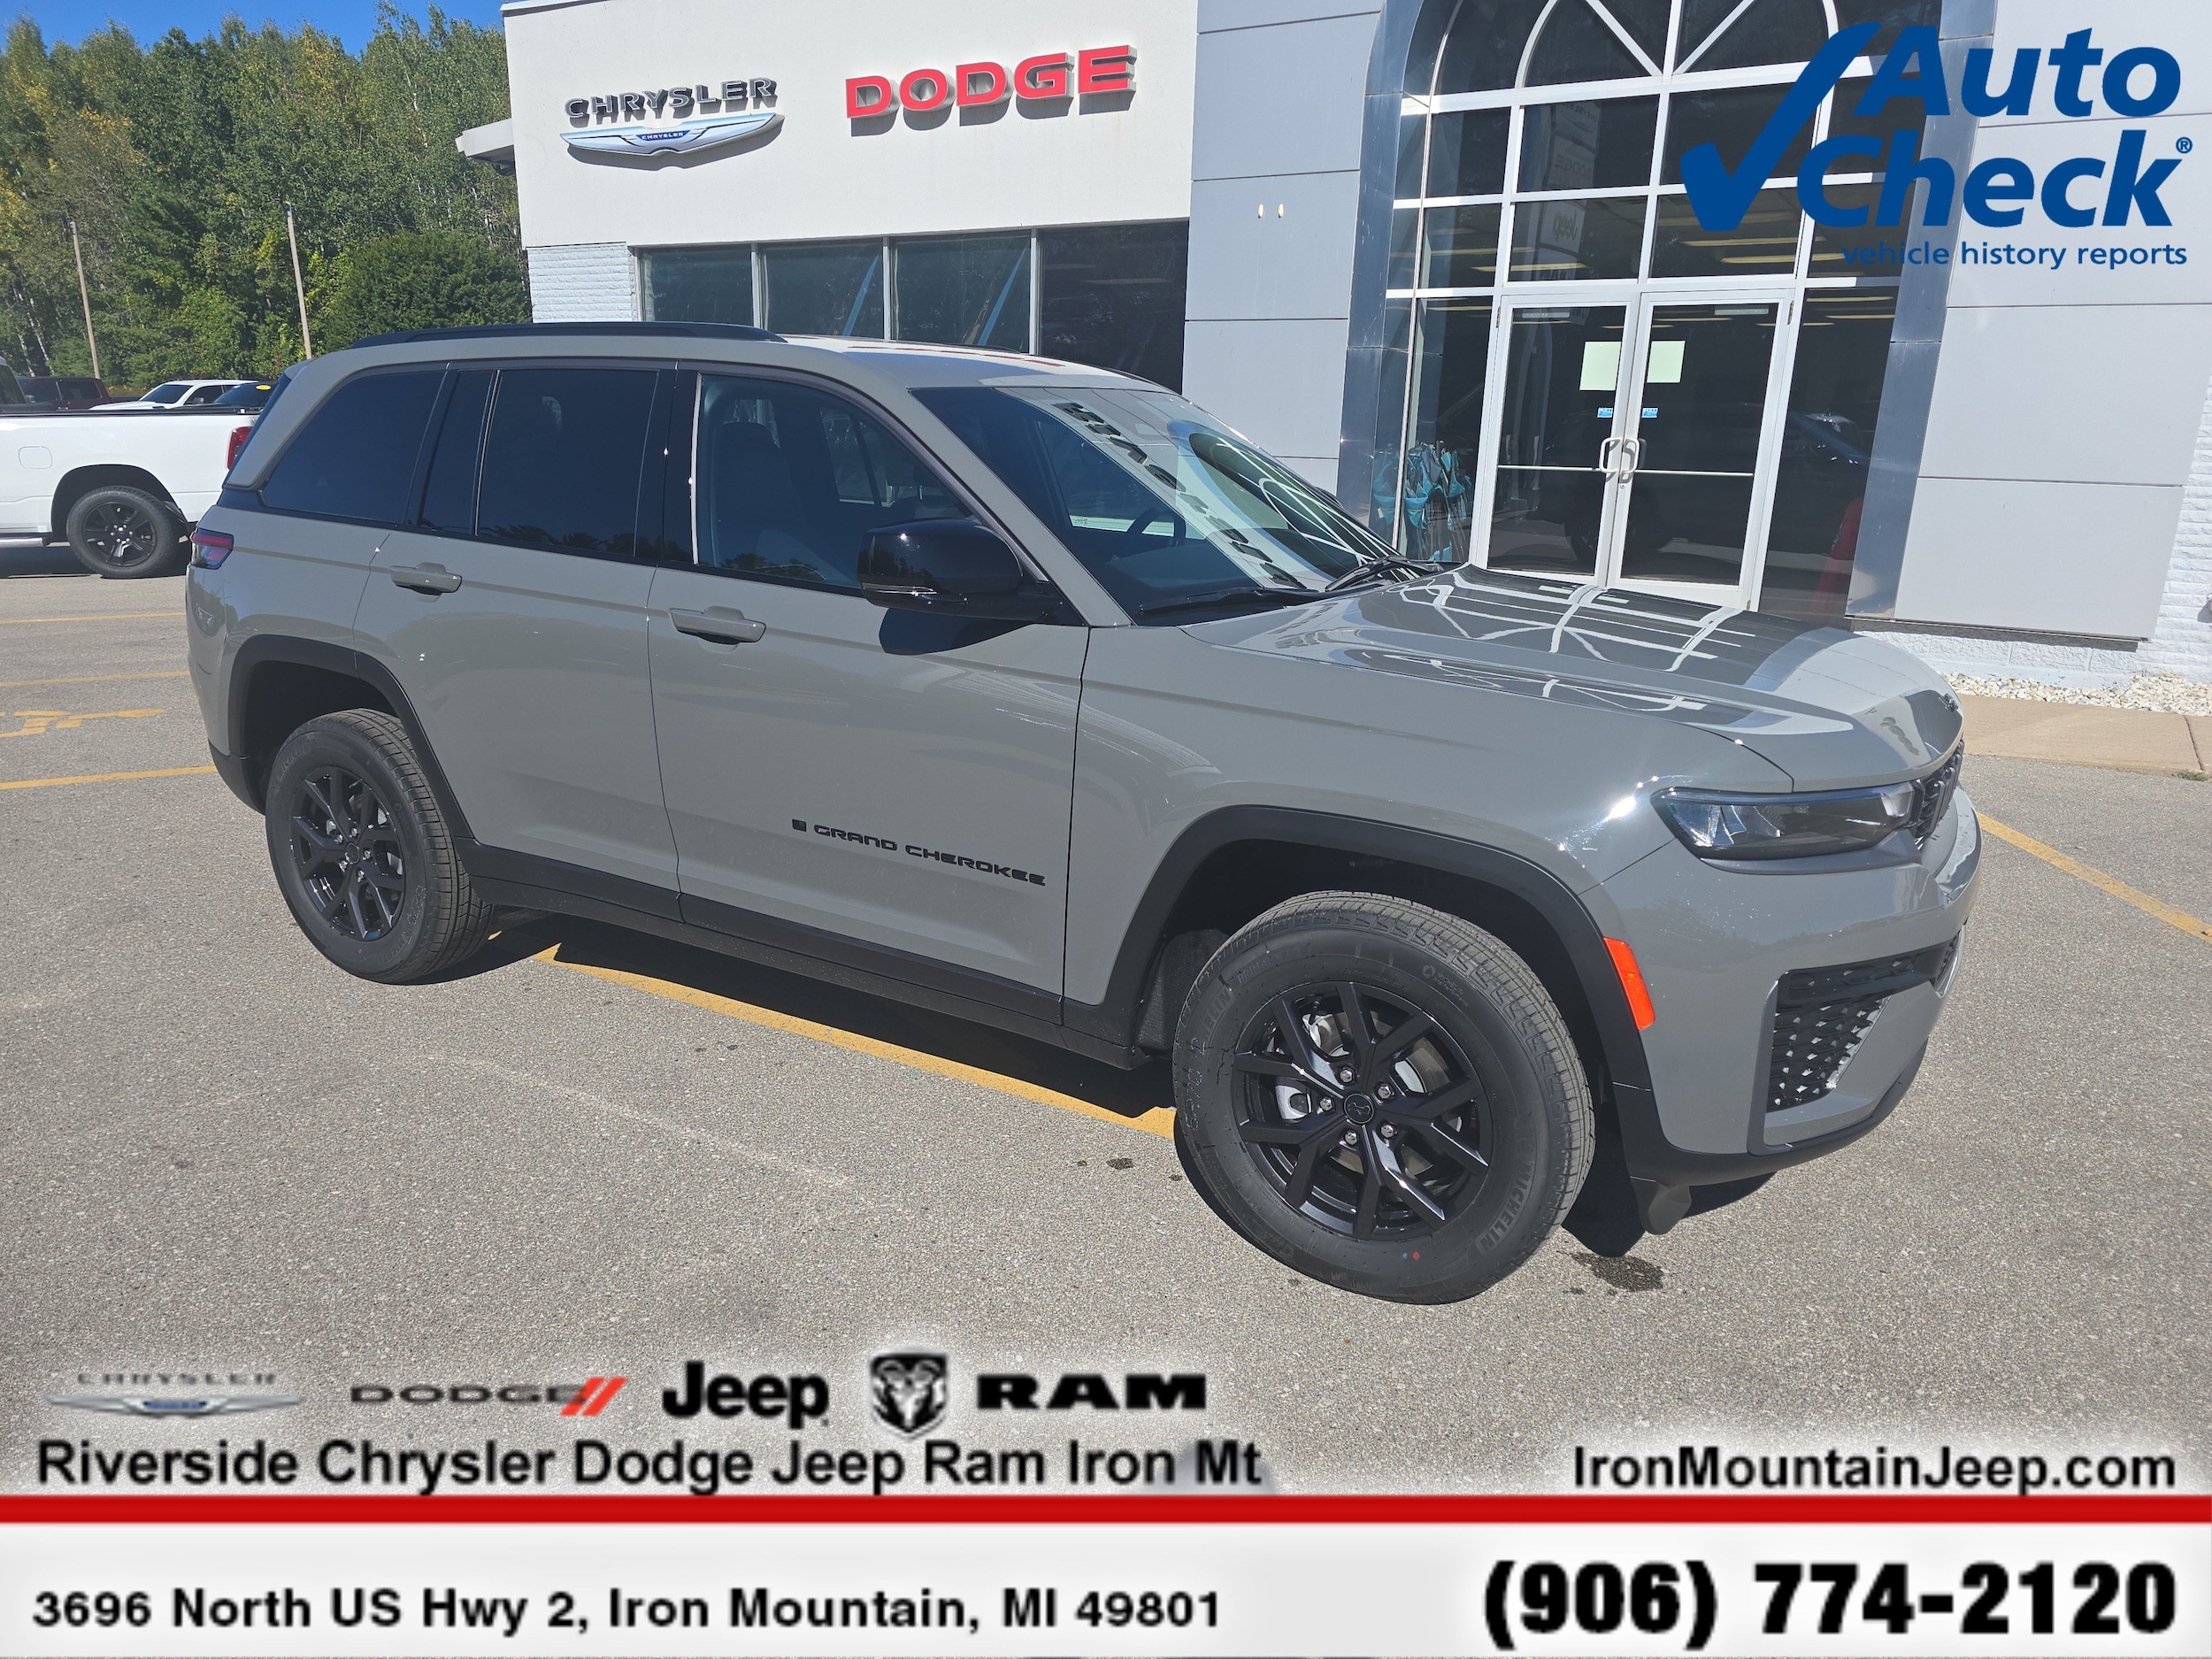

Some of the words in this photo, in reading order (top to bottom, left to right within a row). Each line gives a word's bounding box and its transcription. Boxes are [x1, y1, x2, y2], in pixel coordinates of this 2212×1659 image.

[564, 76, 776, 119] CHRYSLER
[845, 44, 1133, 120] DODGE
[641, 131, 684, 141] CHRYSLER
[813, 825, 898, 851] GRAND
[904, 844, 1046, 887] CHEROKEE
[1479, 1164, 1532, 1253] MICHELIN
